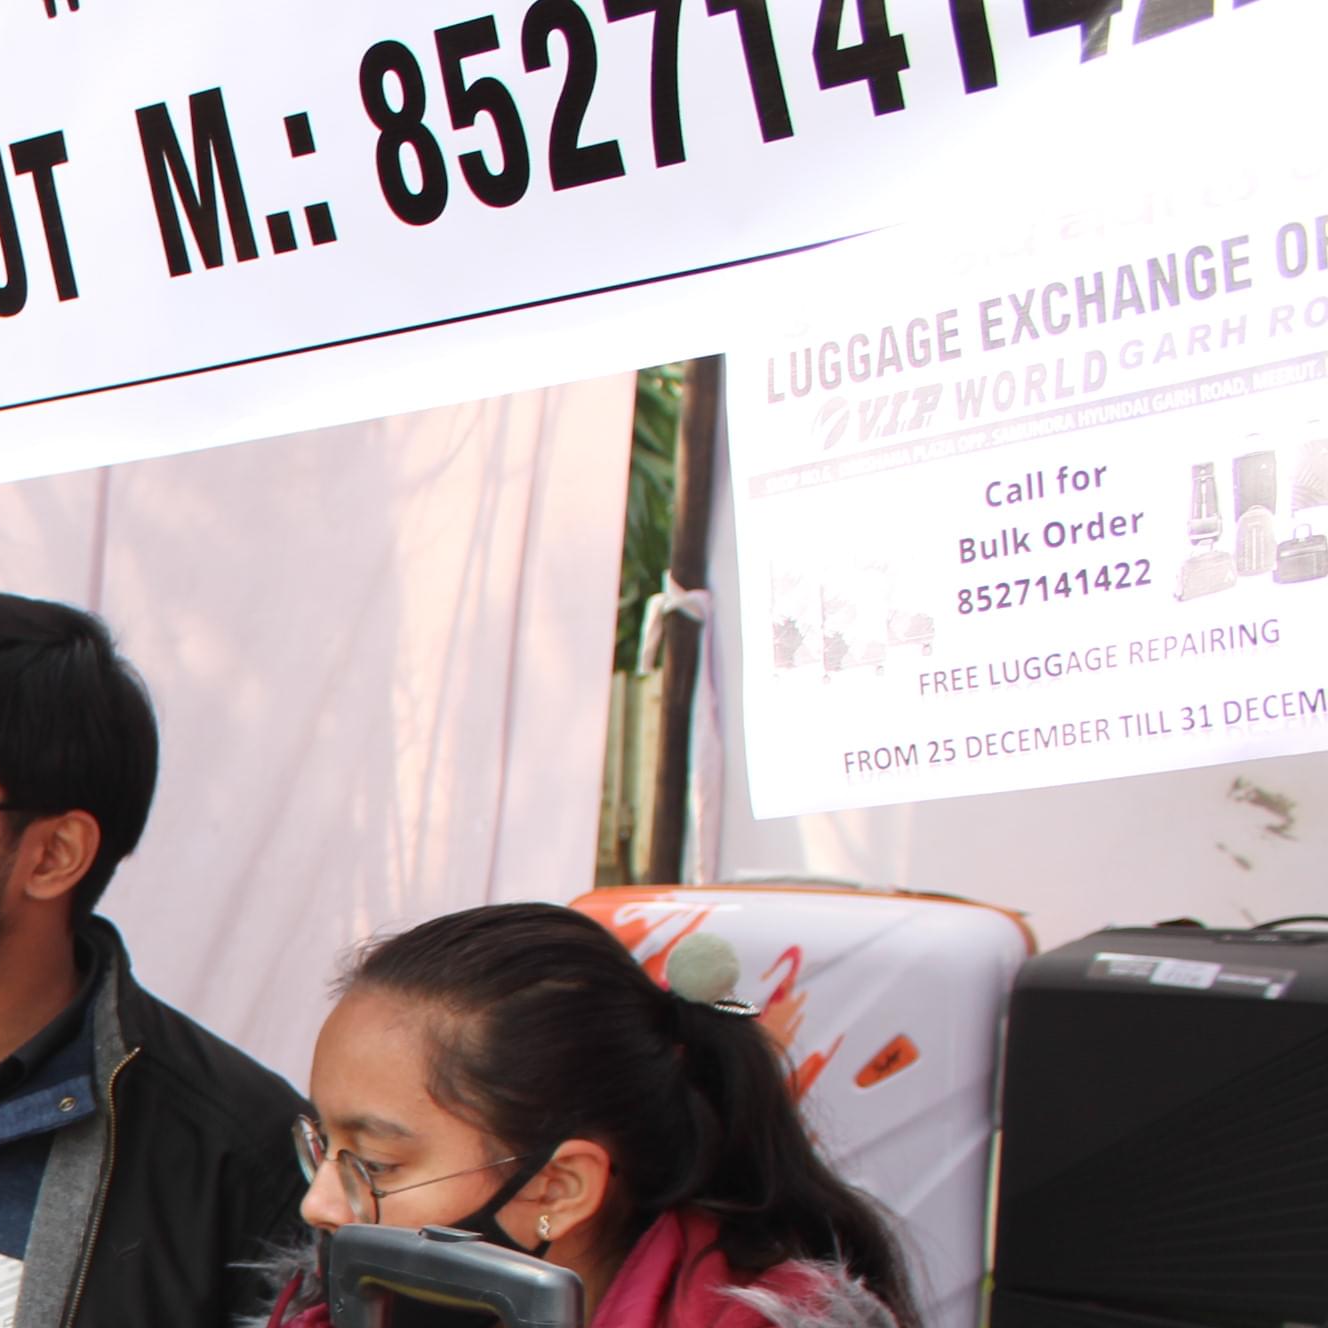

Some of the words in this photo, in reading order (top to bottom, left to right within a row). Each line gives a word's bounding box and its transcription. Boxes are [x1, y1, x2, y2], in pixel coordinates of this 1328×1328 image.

[767, 308, 962, 404] LUGGAGE
[979, 234, 1253, 353] EXCHANGE
[953, 349, 1109, 422] WORLD
[1118, 314, 1247, 370] GARH
[985, 471, 1045, 508] Call
[1056, 464, 1108, 493] for
[959, 524, 1031, 564] Bulk
[1044, 509, 1145, 551] Order
[956, 558, 1152, 616] 8527141422
[919, 665, 980, 697] FREE
[989, 646, 1119, 688] LUGGAGE
[1129, 618, 1282, 665] REPAIRING
[844, 742, 920, 775] FROM
[927, 739, 957, 764] 25
[966, 718, 1111, 760] DECEMBER
[1119, 711, 1173, 740] TILL
[1181, 704, 1213, 731] 31
[1223, 688, 1328, 726] DECEM
